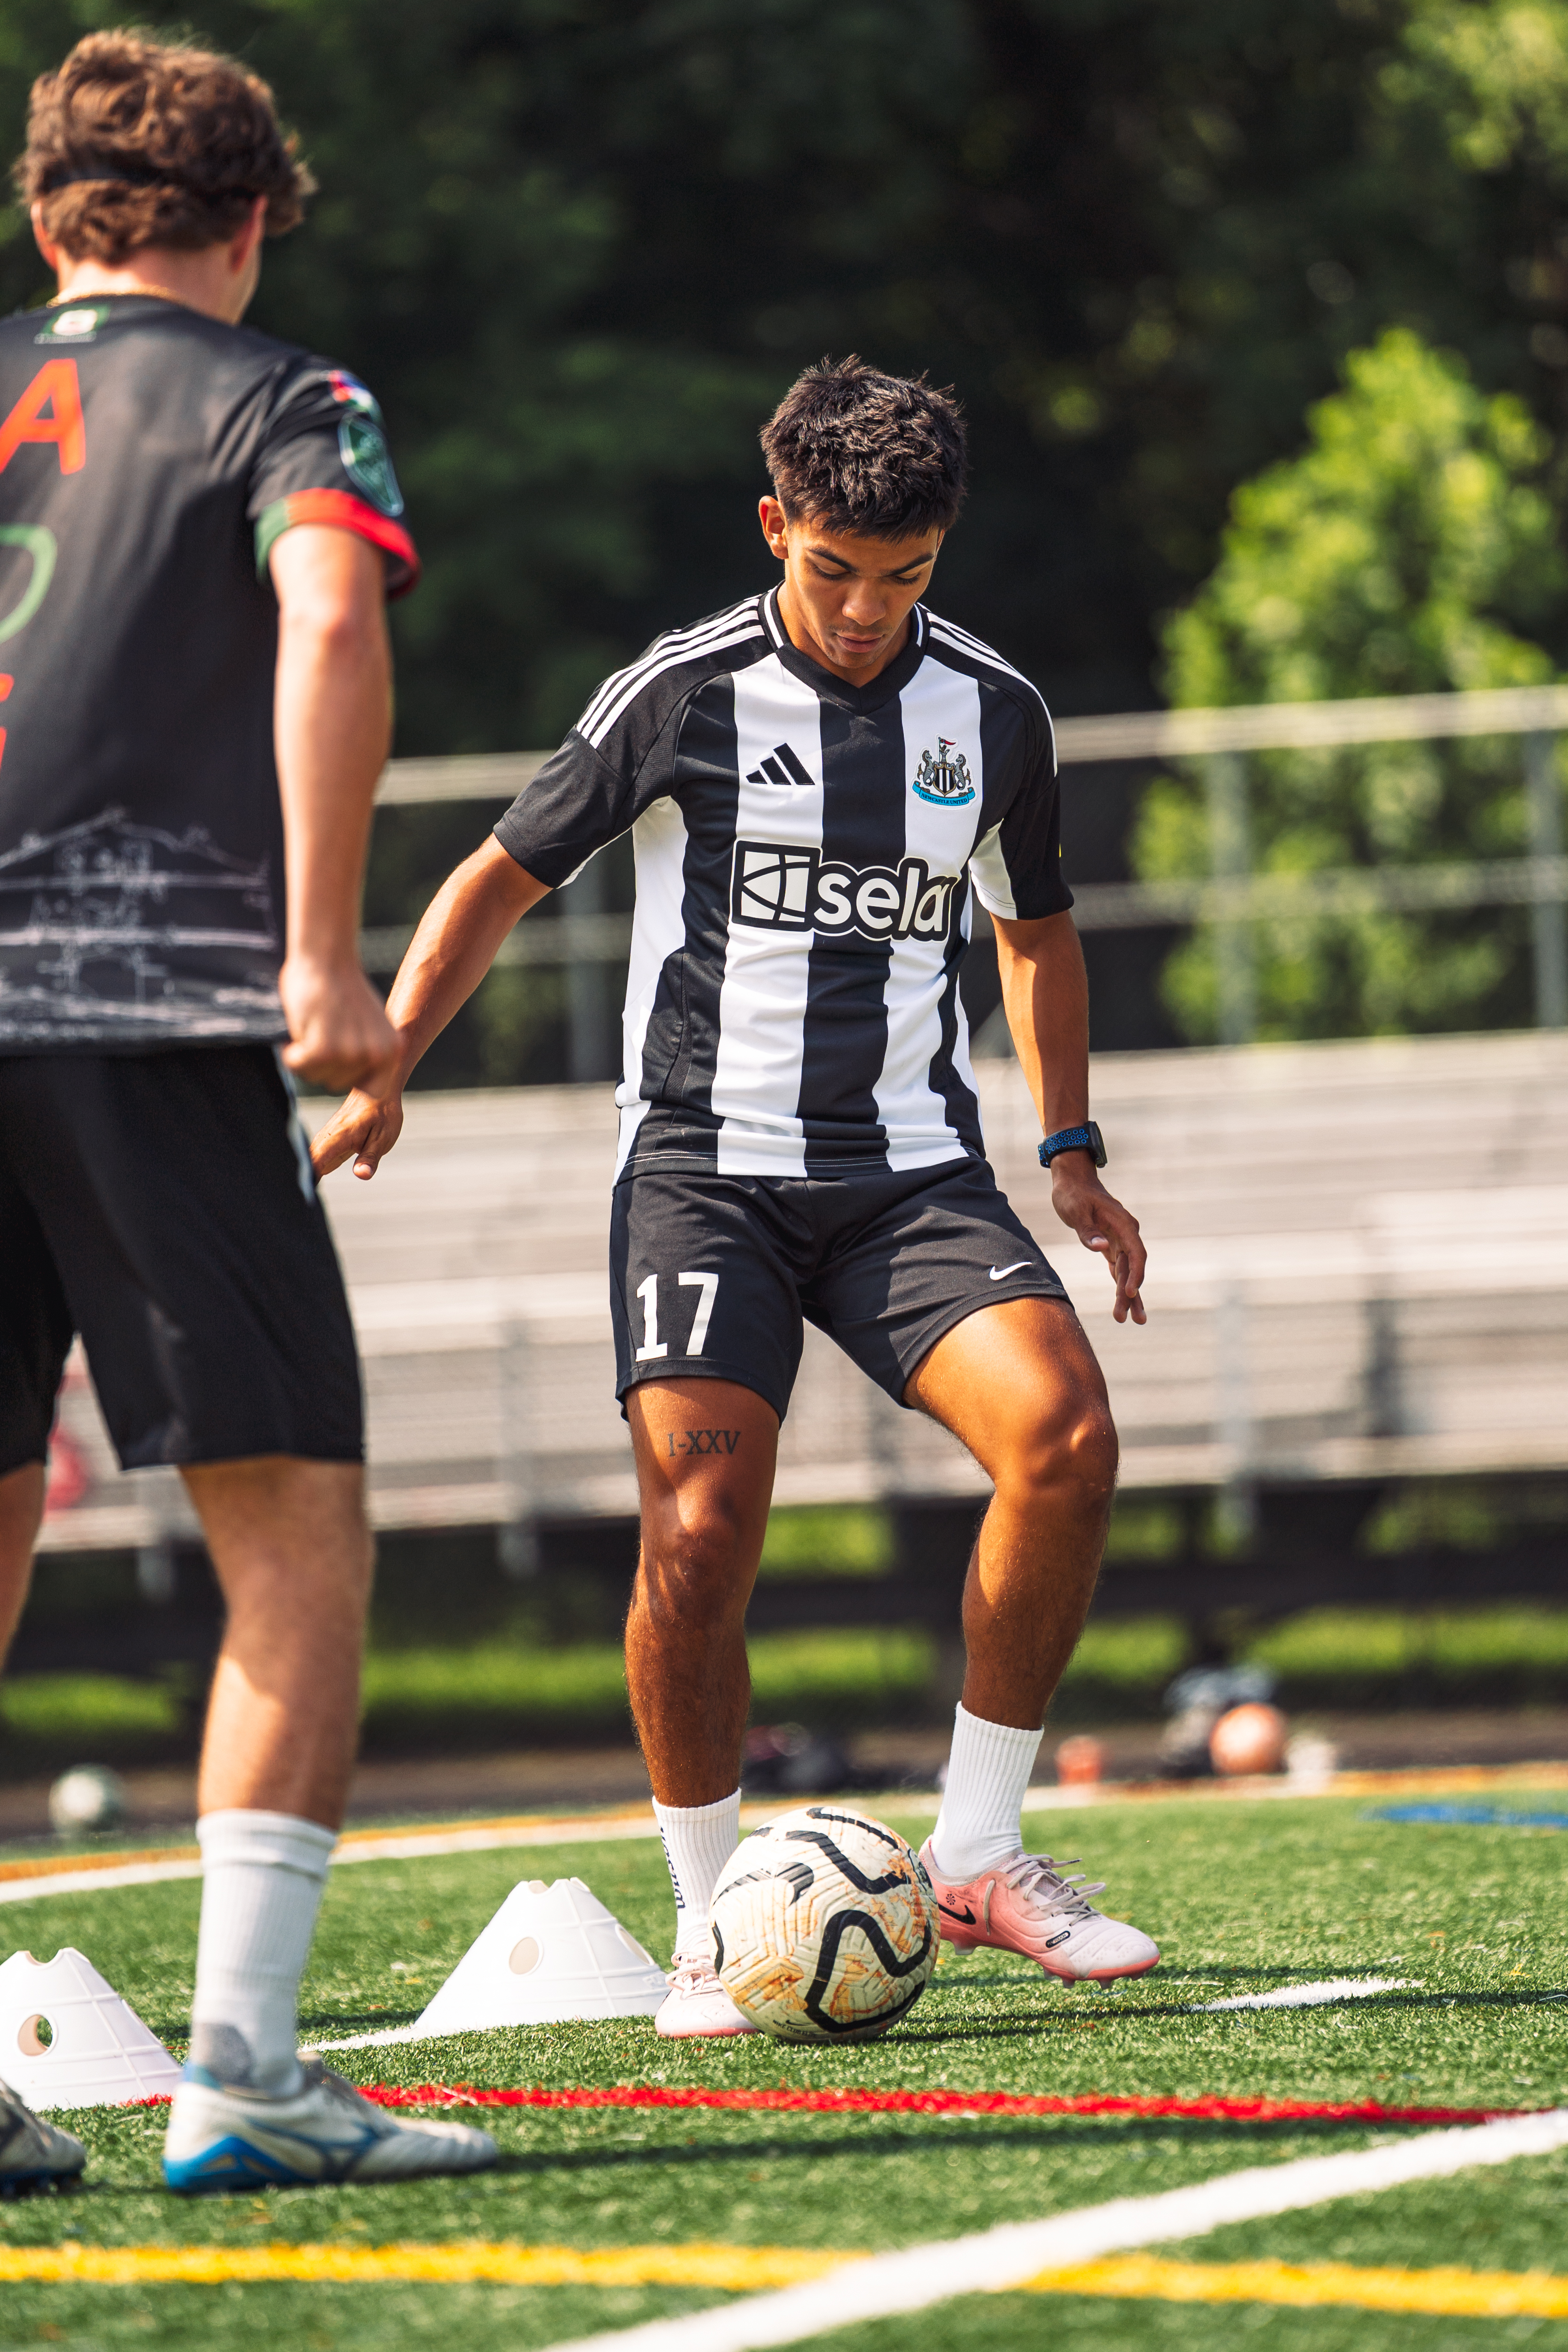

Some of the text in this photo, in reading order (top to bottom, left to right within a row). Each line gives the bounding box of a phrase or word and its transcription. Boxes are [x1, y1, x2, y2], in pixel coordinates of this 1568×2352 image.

[921, 793, 949, 803] NEWCASTLE
[814, 867, 949, 932] sela
[635, 1271, 719, 1362] 17
[667, 1430, 741, 1457] I-XXV
[773, 2020, 786, 2029] NIKE
